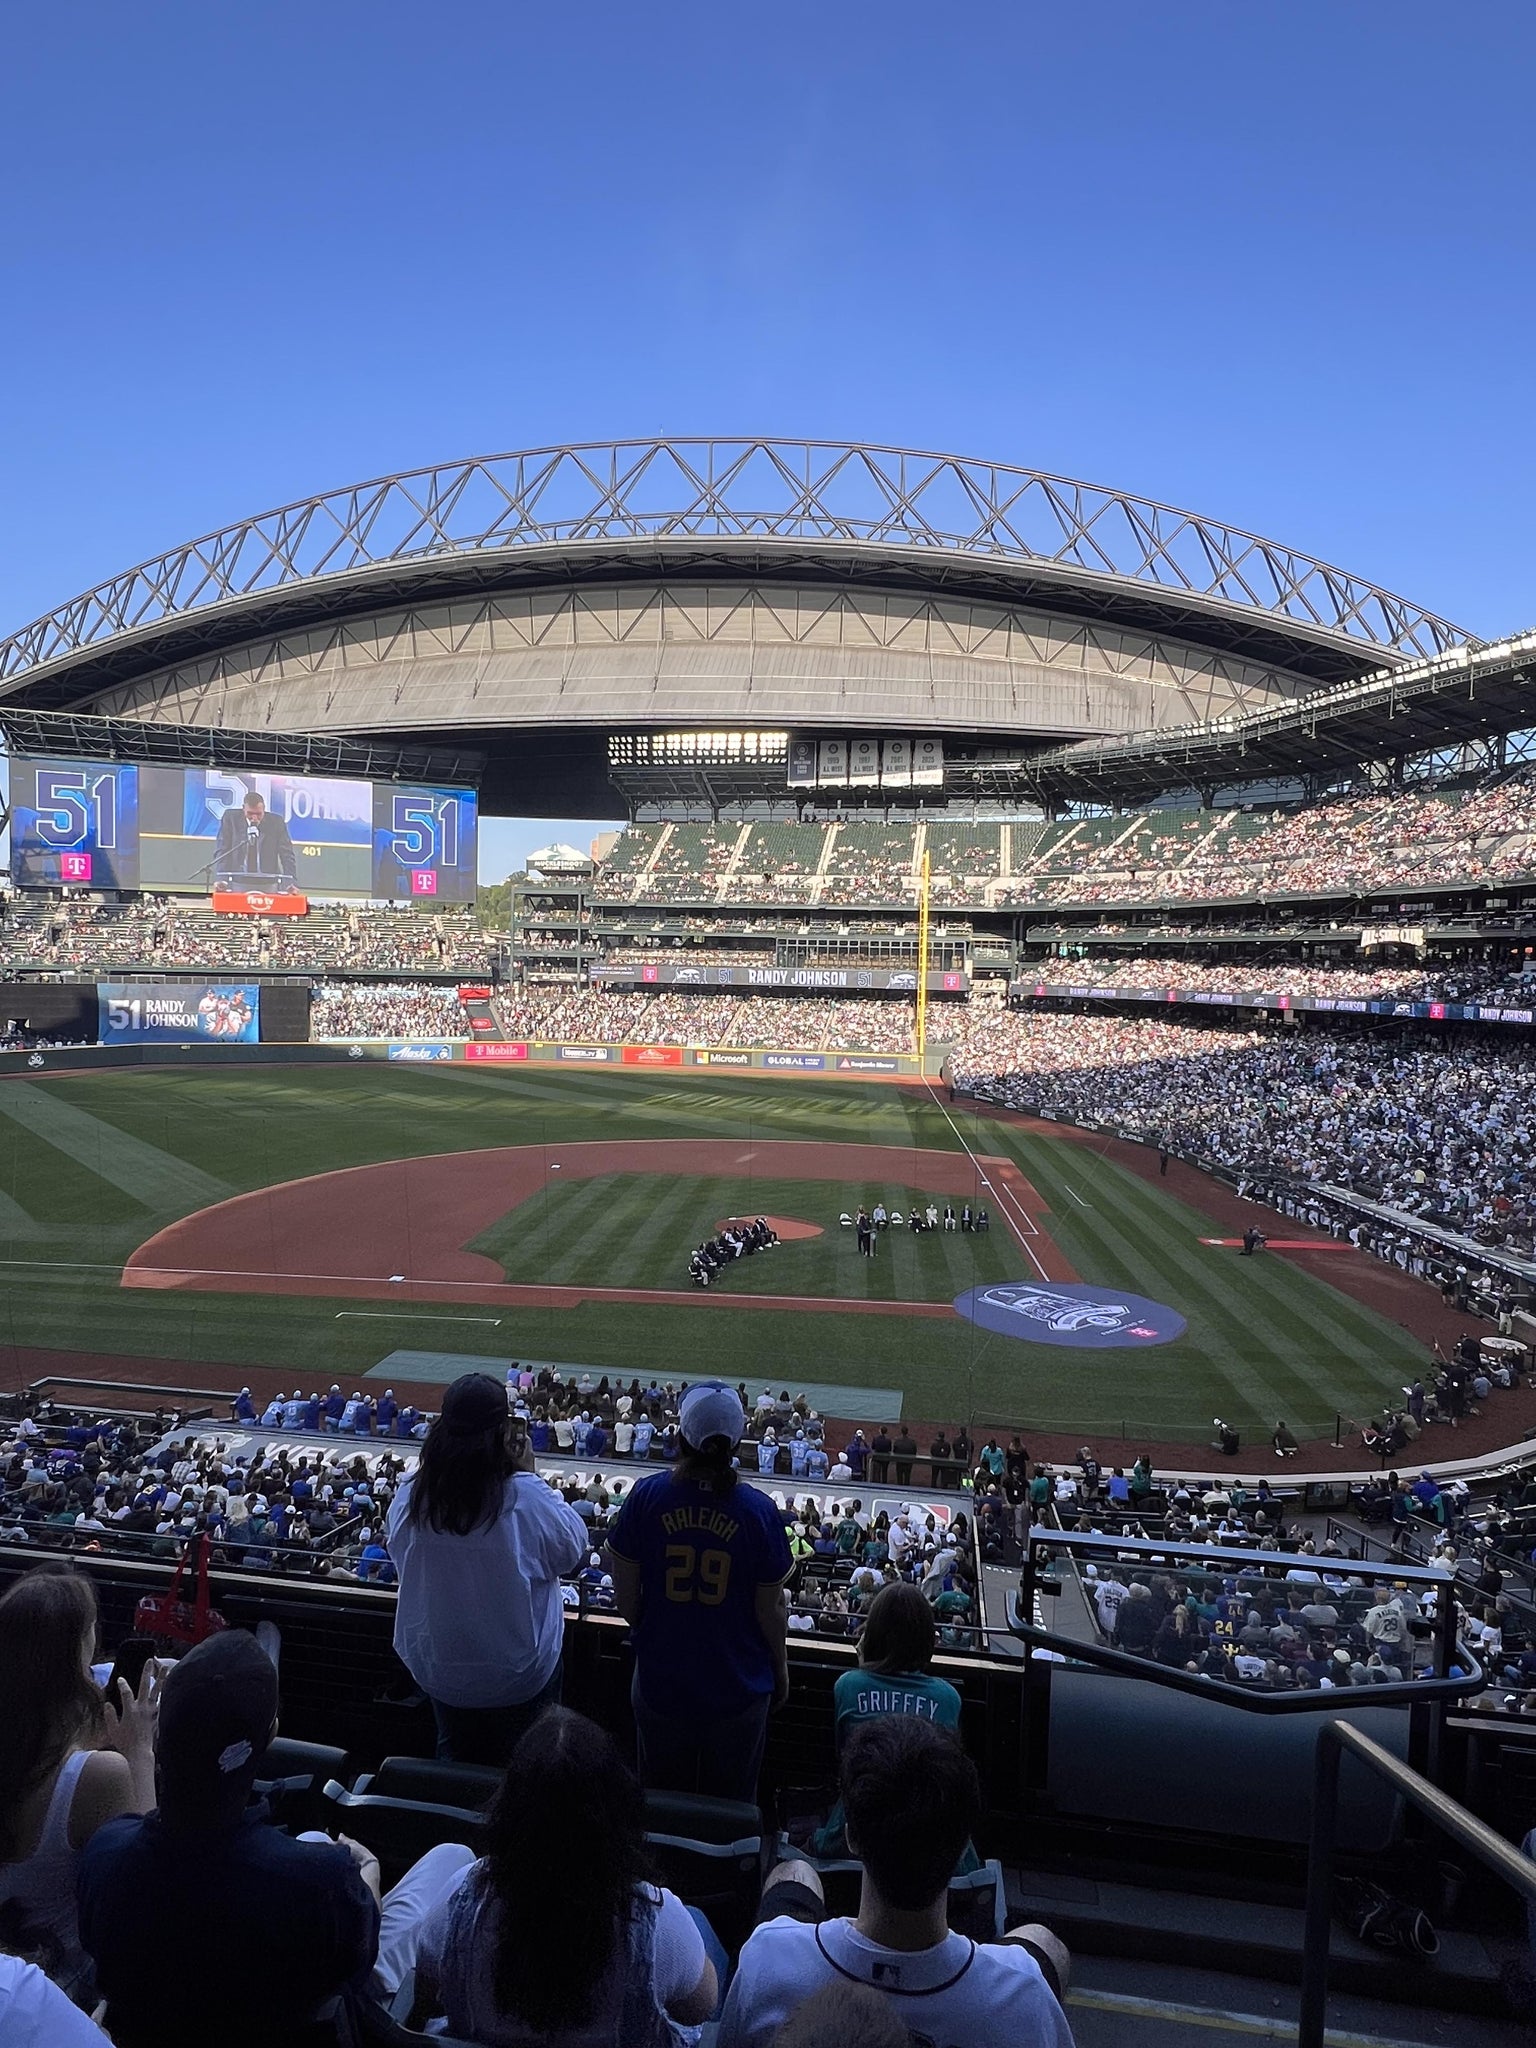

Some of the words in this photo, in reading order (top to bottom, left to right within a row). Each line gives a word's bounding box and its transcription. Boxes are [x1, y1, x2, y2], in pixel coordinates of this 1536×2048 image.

[36, 769, 116, 848] 51
[392, 795, 458, 866] 51
[302, 846, 321, 857] 401
[247, 894, 263, 905] fire
[264, 896, 275, 905] tv
[719, 969, 732, 984] 51
[749, 969, 787, 984] RANDY
[790, 971, 848, 986] JOHNSON
[857, 972, 873, 987] 51
[146, 1000, 186, 1014] RANDY
[1315, 999, 1335, 1010] RANDY
[1336, 1000, 1367, 1012] JOHNSON
[108, 999, 141, 1030] 51
[143, 1013, 199, 1029] JOHNSON
[1479, 1007, 1500, 1020] RANDY
[1500, 1009, 1533, 1023] JOHNSON
[391, 1046, 432, 1059] Alaska
[485, 1045, 519, 1057] Mobile
[710, 1052, 748, 1064] Microsoft
[767, 1056, 804, 1066] GLOBAL
[661, 1507, 739, 1543] RALEIGH
[665, 1544, 732, 1605] 29
[1214, 1620, 1234, 1636] 24
[1383, 1617, 1398, 1632] 29
[857, 1690, 940, 1720] GRIFFEY
